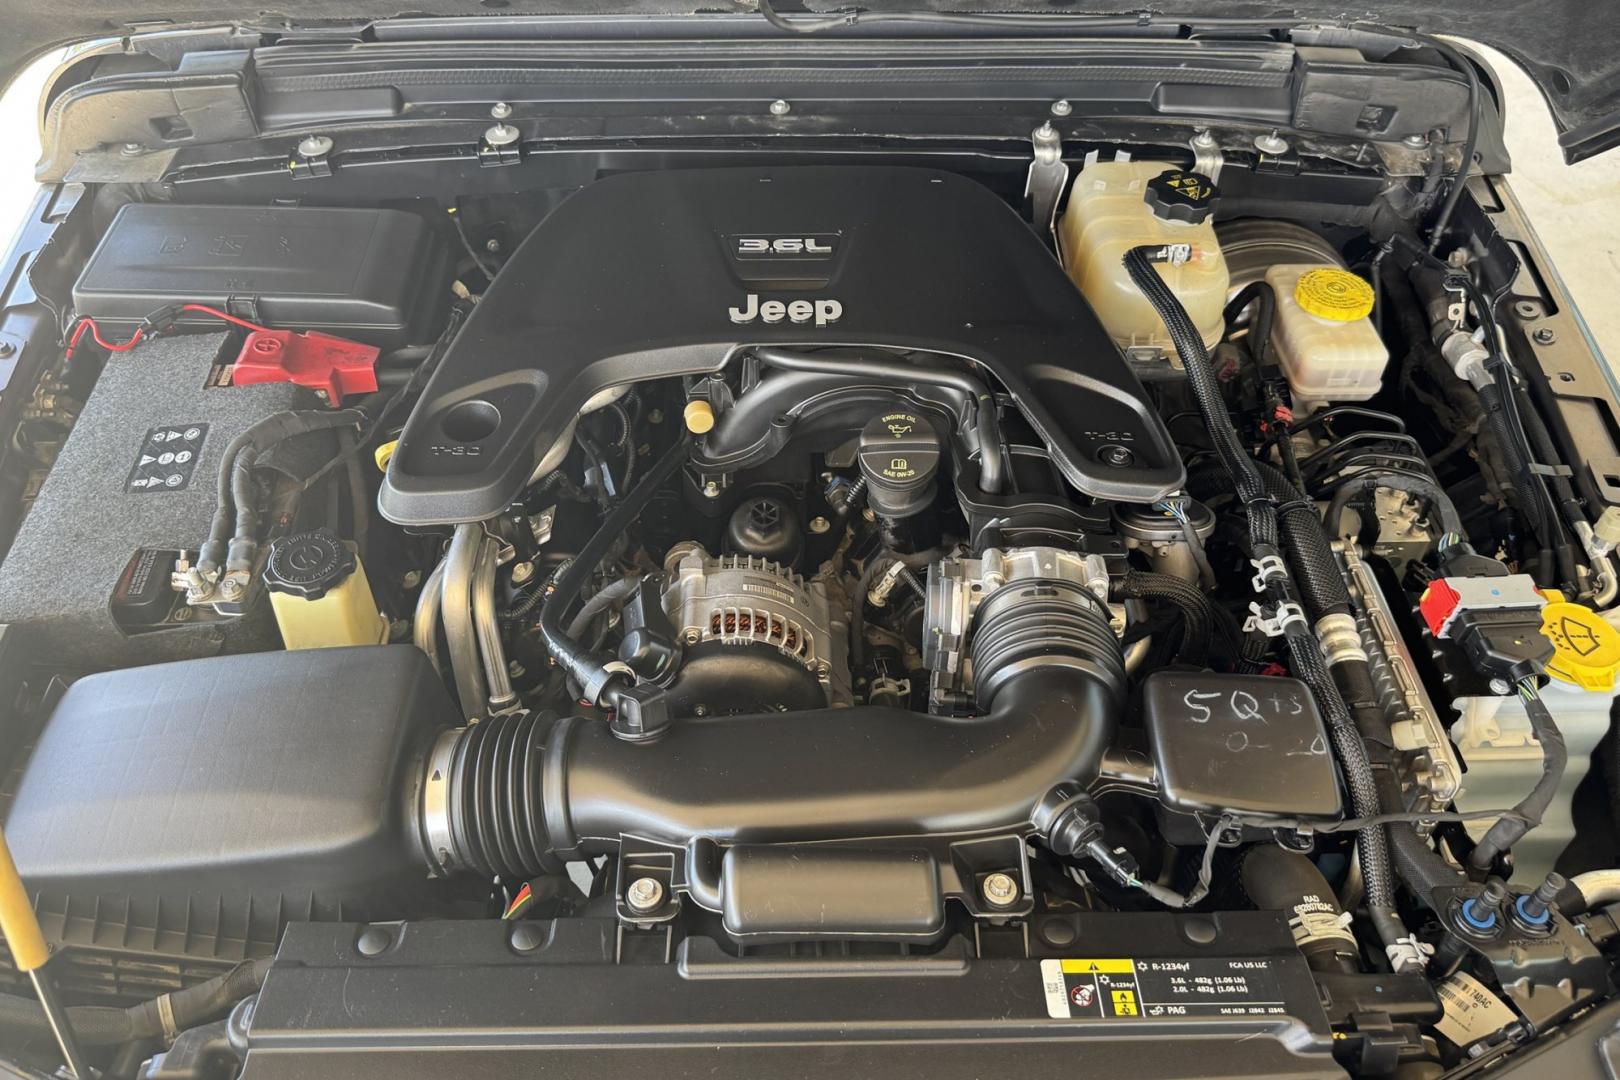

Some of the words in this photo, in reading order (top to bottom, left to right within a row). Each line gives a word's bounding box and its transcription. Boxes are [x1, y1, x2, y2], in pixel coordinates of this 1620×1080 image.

[738, 238, 832, 254] 3.6L
[728, 294, 843, 328] Jeep
[906, 415, 916, 423] OIL
[883, 469, 896, 477] SAE
[1303, 894, 1320, 904] RAD
[1151, 962, 1190, 972] R-1234yf
[1167, 1006, 1187, 1015] PAG
